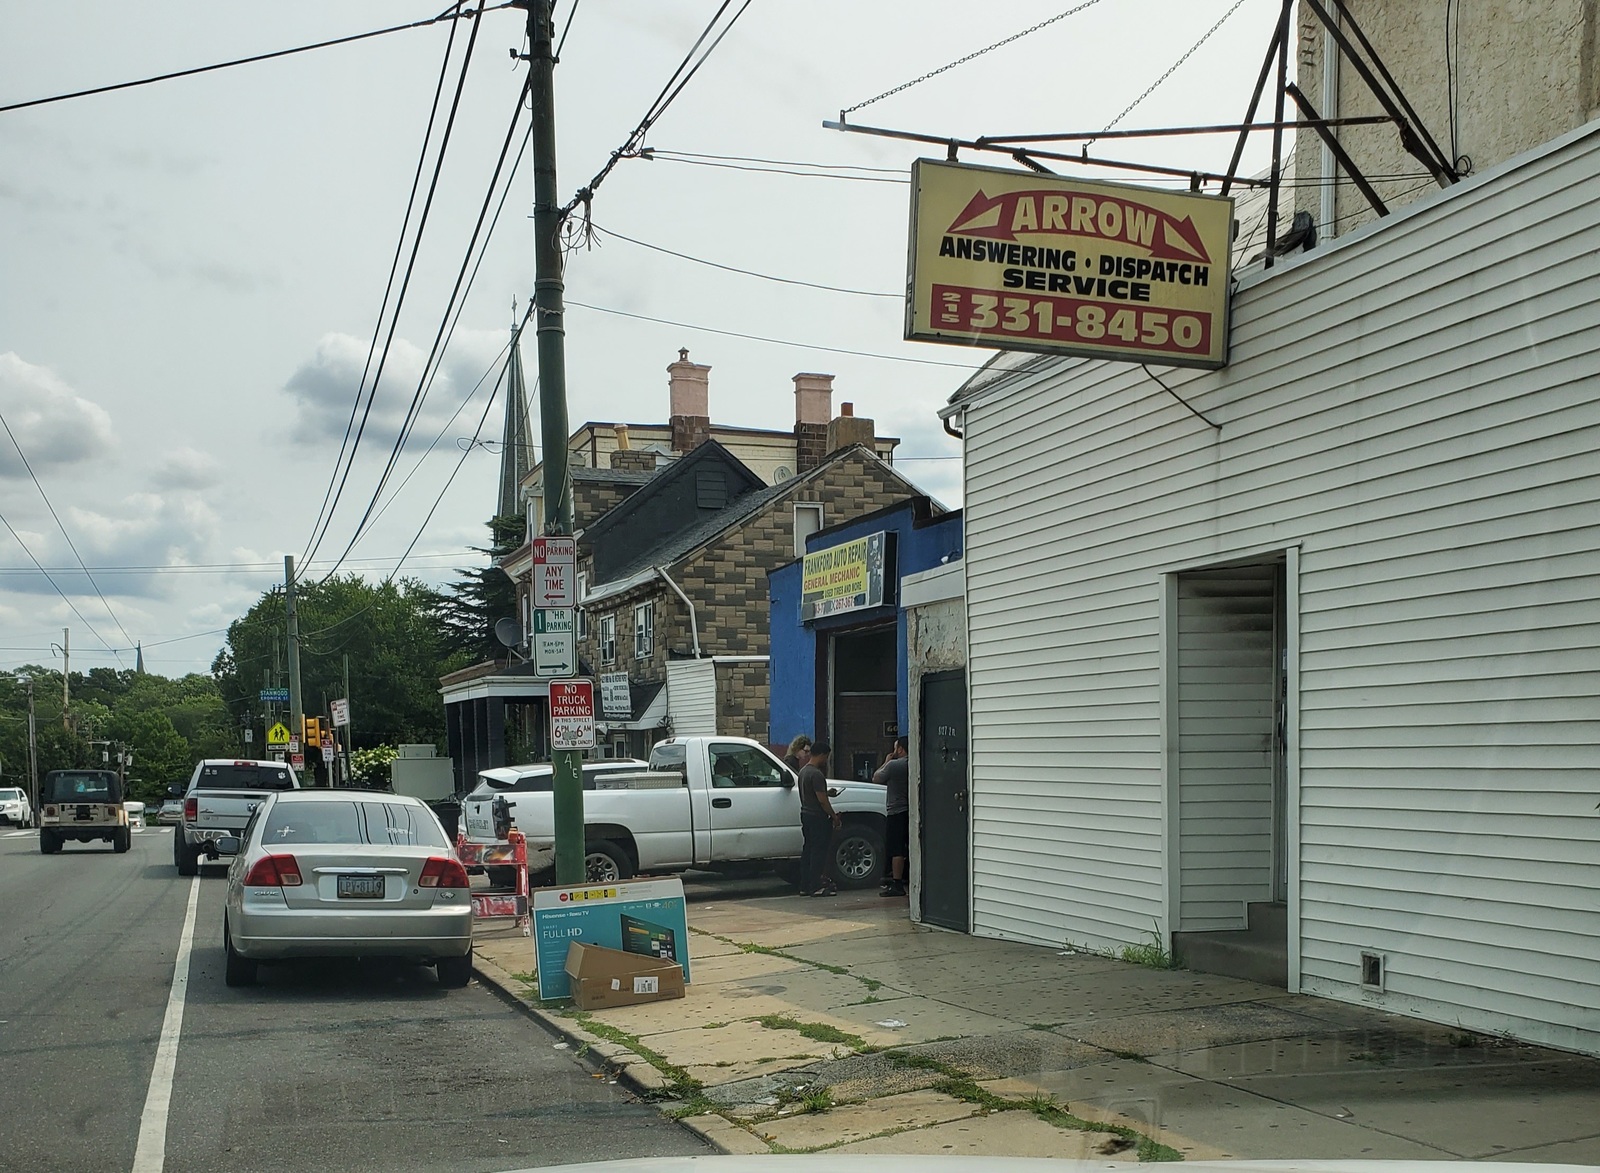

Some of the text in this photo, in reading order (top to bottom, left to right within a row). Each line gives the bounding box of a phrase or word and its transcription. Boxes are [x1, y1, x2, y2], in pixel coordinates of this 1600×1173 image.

[1011, 195, 1157, 247] ARROW
[939, 236, 1209, 287] ANSWERING DISPATCH
[1003, 268, 1150, 302] SERVICE
[969, 293, 1202, 349] 331-8450
[534, 545, 573, 558] NO PARKING
[805, 541, 867, 577] FRANKFORD AUTO REPAIR
[545, 566, 563, 577] ANY
[804, 566, 860, 591] GENERAL MECHANIC
[544, 579, 564, 590] TIME
[834, 585, 844, 597] TIRES
[844, 583, 852, 594] AND
[852, 581, 862, 592] MORE
[537, 610, 565, 630] 1 HR
[547, 621, 572, 631] PARKING
[564, 684, 578, 694] NO
[557, 695, 587, 705] TRUCK
[553, 705, 591, 716] PARKING
[543, 928, 583, 939] FULL HD
